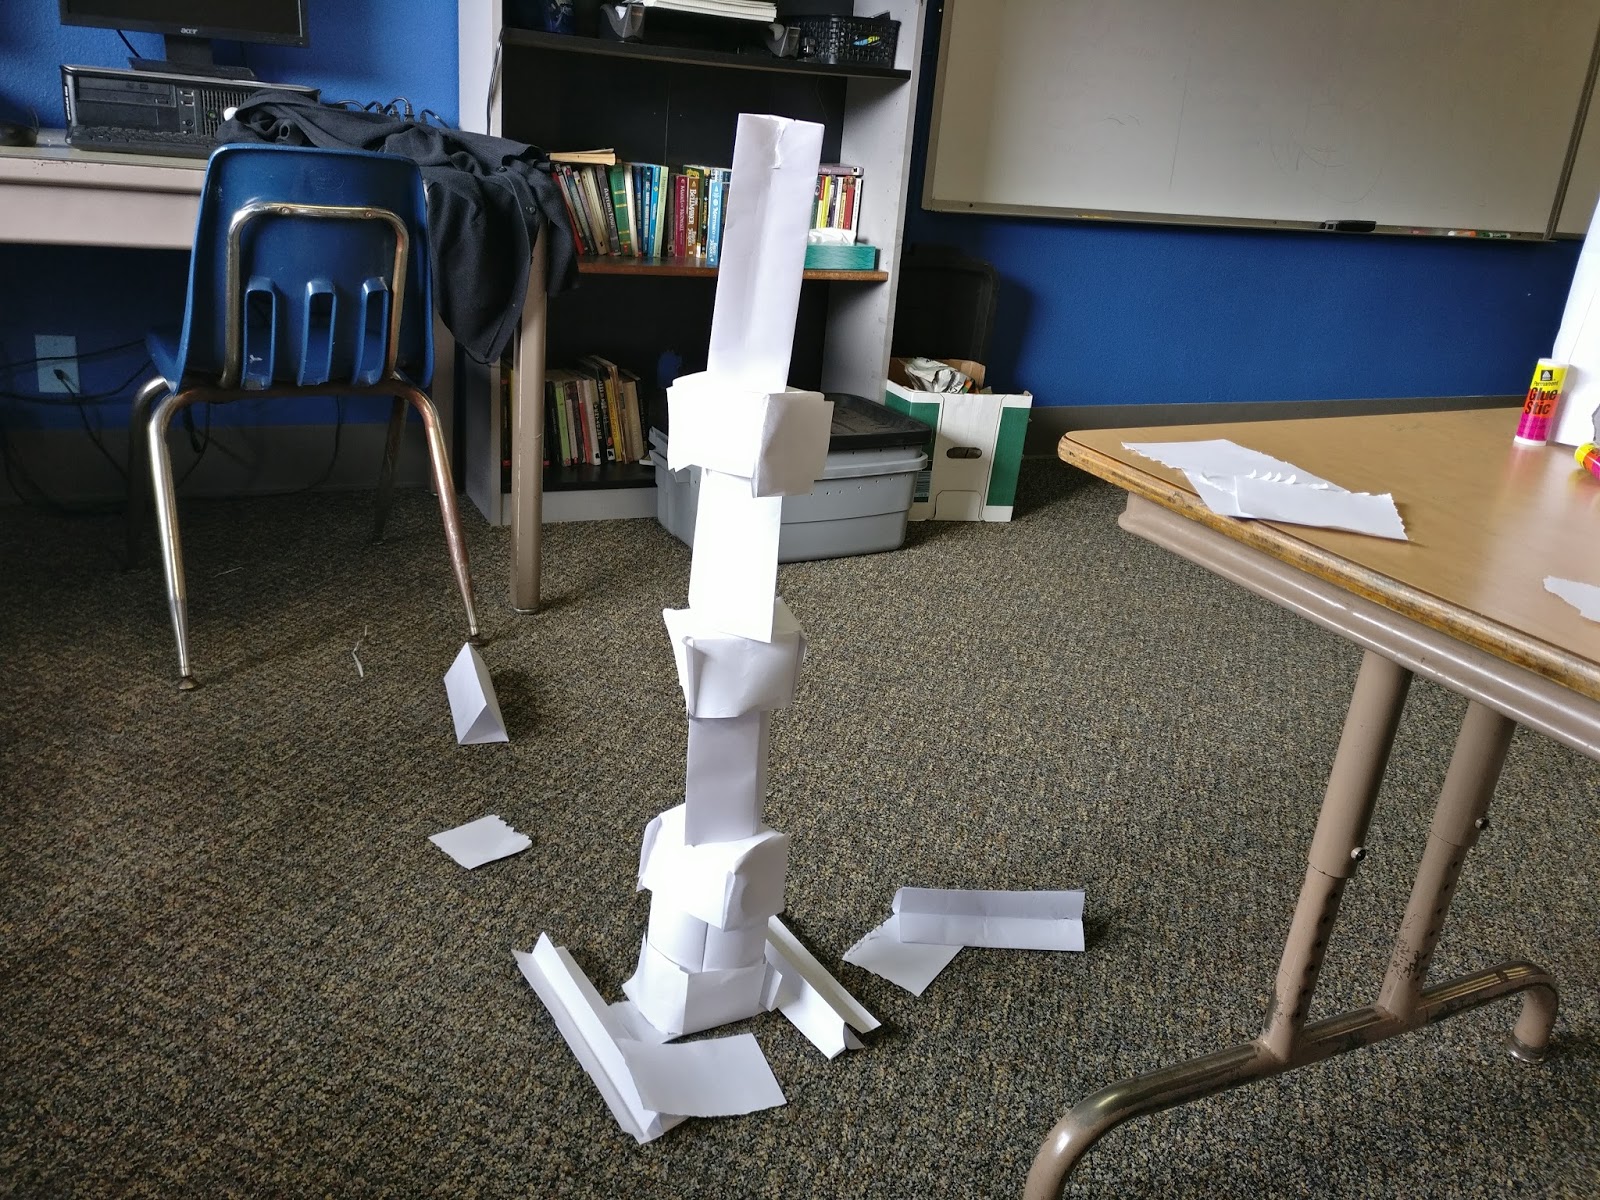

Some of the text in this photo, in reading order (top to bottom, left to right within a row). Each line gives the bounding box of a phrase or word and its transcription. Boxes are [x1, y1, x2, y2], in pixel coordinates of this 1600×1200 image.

[180, 27, 198, 35] acer
[1529, 387, 1558, 401] Glue
[1525, 401, 1551, 415] Stic
